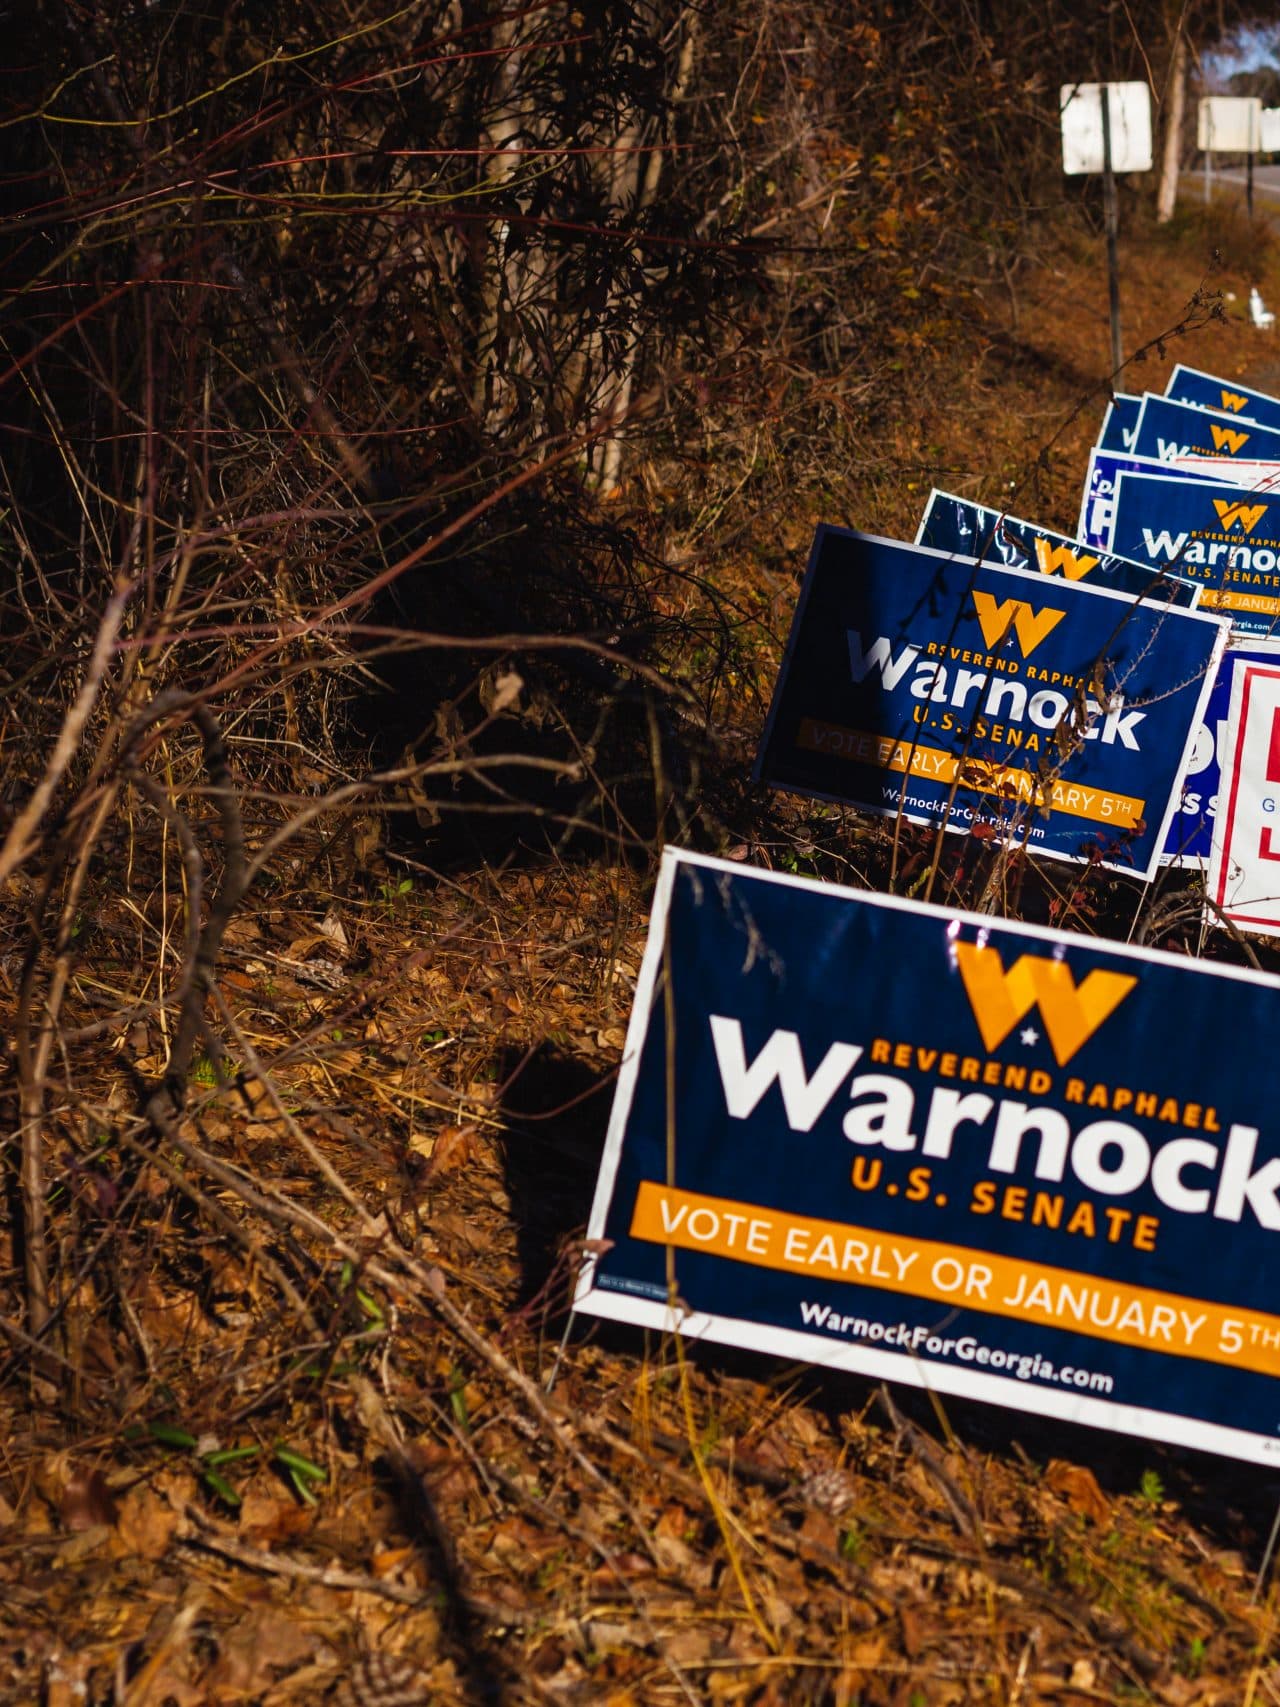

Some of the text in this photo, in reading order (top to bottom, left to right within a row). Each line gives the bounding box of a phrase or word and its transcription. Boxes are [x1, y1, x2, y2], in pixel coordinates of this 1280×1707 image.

[1210, 424, 1250, 455] W
[1213, 499, 1268, 534] W
[1187, 566, 1280, 587] U.S. SENATE
[972, 590, 1067, 659] W
[847, 630, 1147, 752] Warnock
[1026, 665, 1104, 693] RAPHE
[913, 705, 1073, 758] U.S. SENA
[813, 728, 873, 753] VOTE
[877, 742, 946, 775] EARLY
[1100, 796, 1132, 817] 5TH
[881, 786, 1045, 839] WarnockForGergia.cm
[955, 941, 1137, 1066] W
[871, 1039, 1220, 1131] REVEREND RAPHAEL
[852, 1157, 1159, 1252] U.S. SENATE
[660, 1199, 771, 1255] VOTE
[784, 1229, 920, 1283] EARLY
[931, 1258, 993, 1298] OR
[1002, 1276, 1209, 1346] JANUARY
[799, 1302, 1113, 1393] WarnockForGeorgia.com
